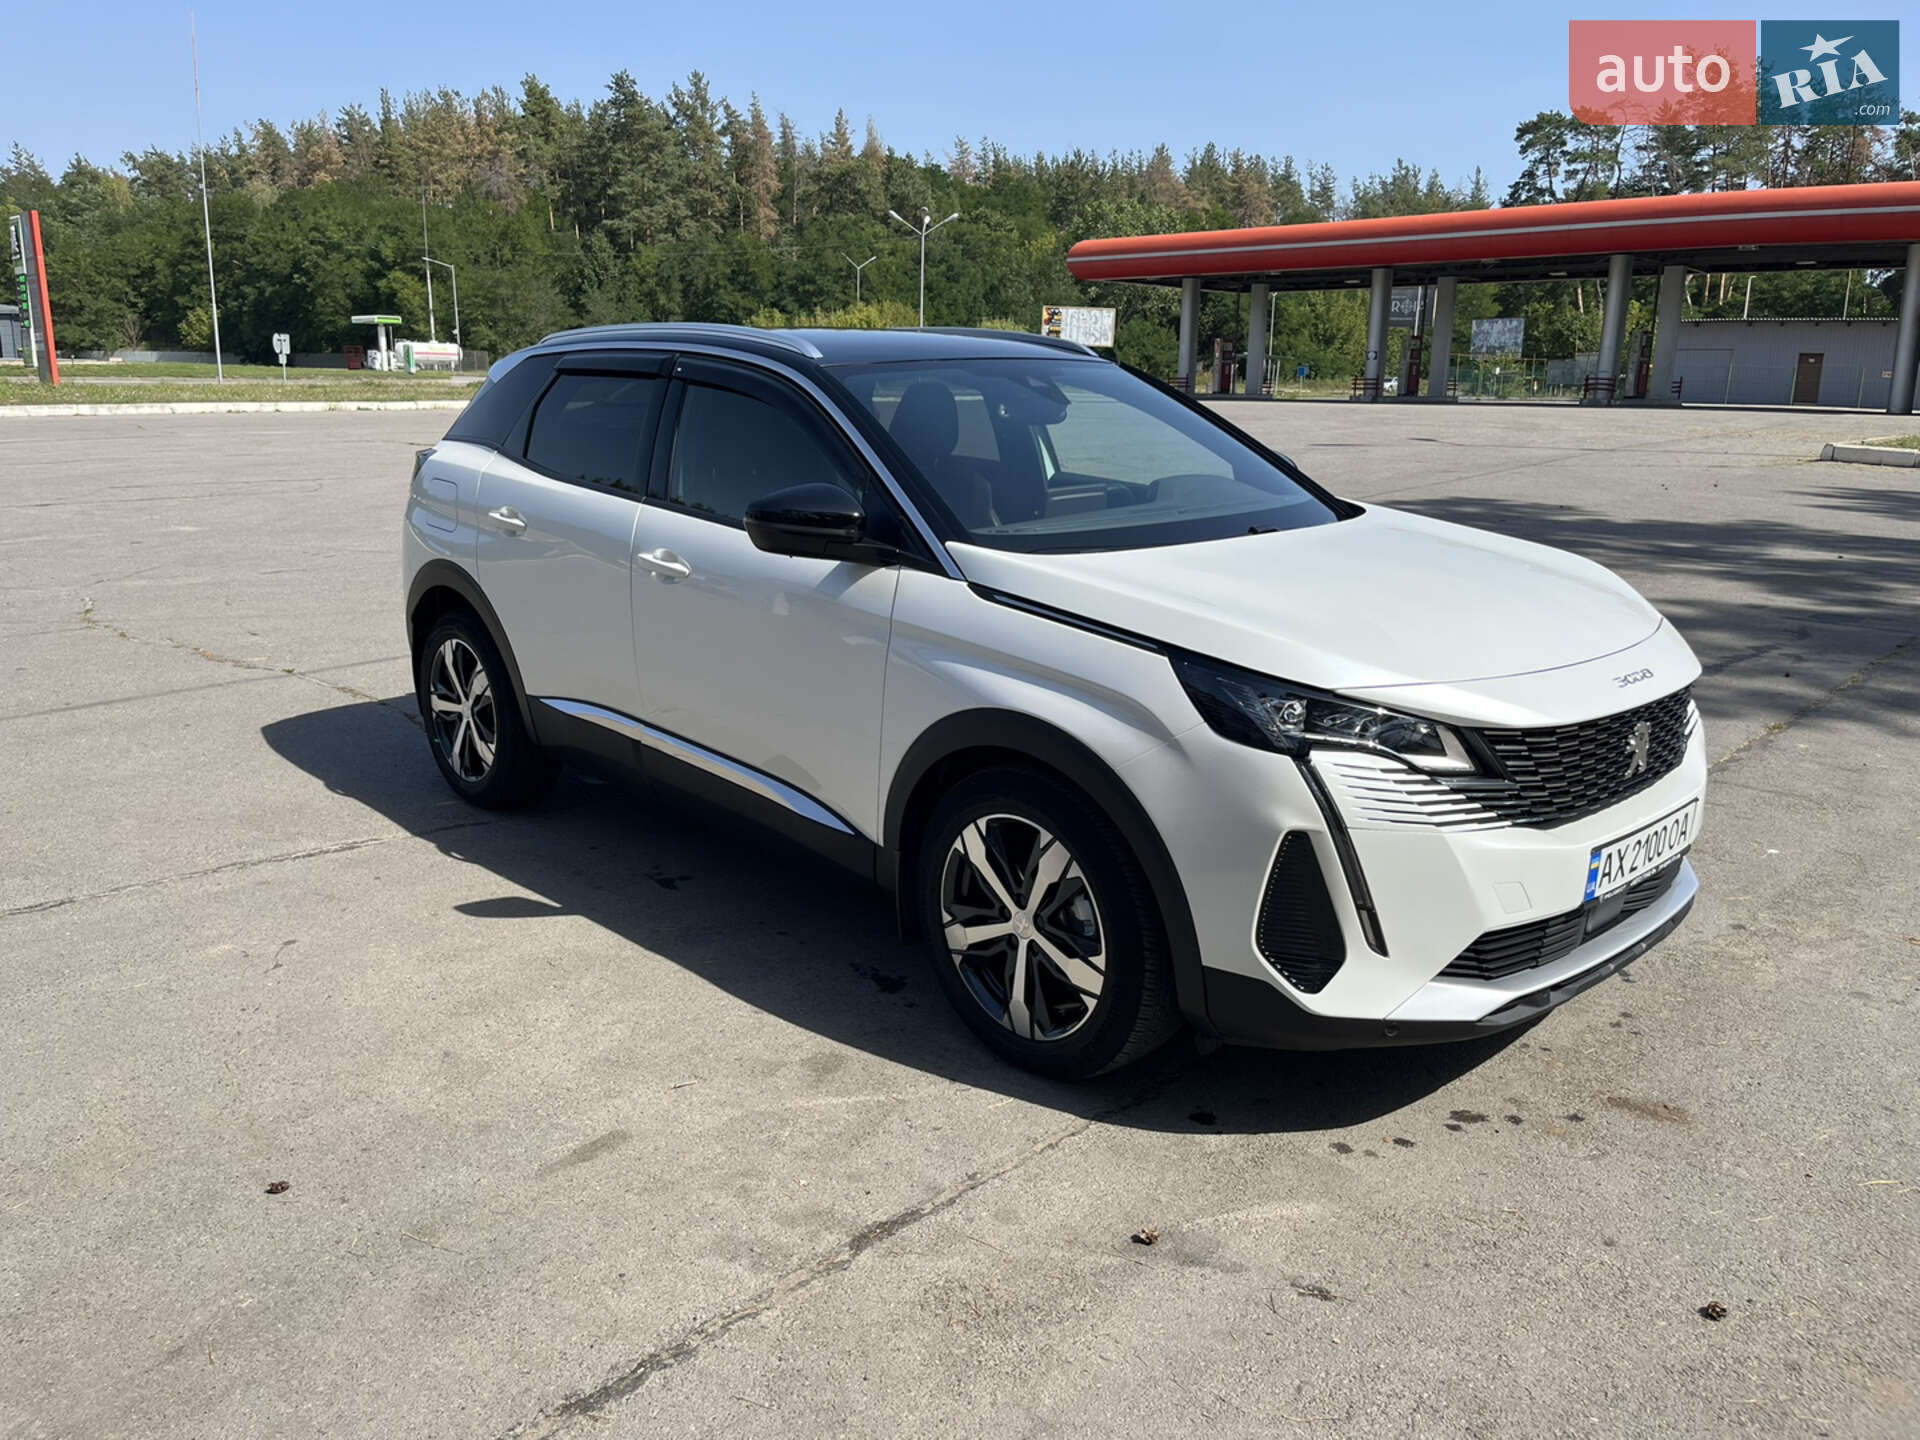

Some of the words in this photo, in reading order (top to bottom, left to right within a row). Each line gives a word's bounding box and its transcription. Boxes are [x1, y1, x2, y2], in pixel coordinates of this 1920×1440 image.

[1598, 844, 1630, 889] AX
[1628, 824, 1668, 874] 2100
[1668, 812, 1689, 850] OA
